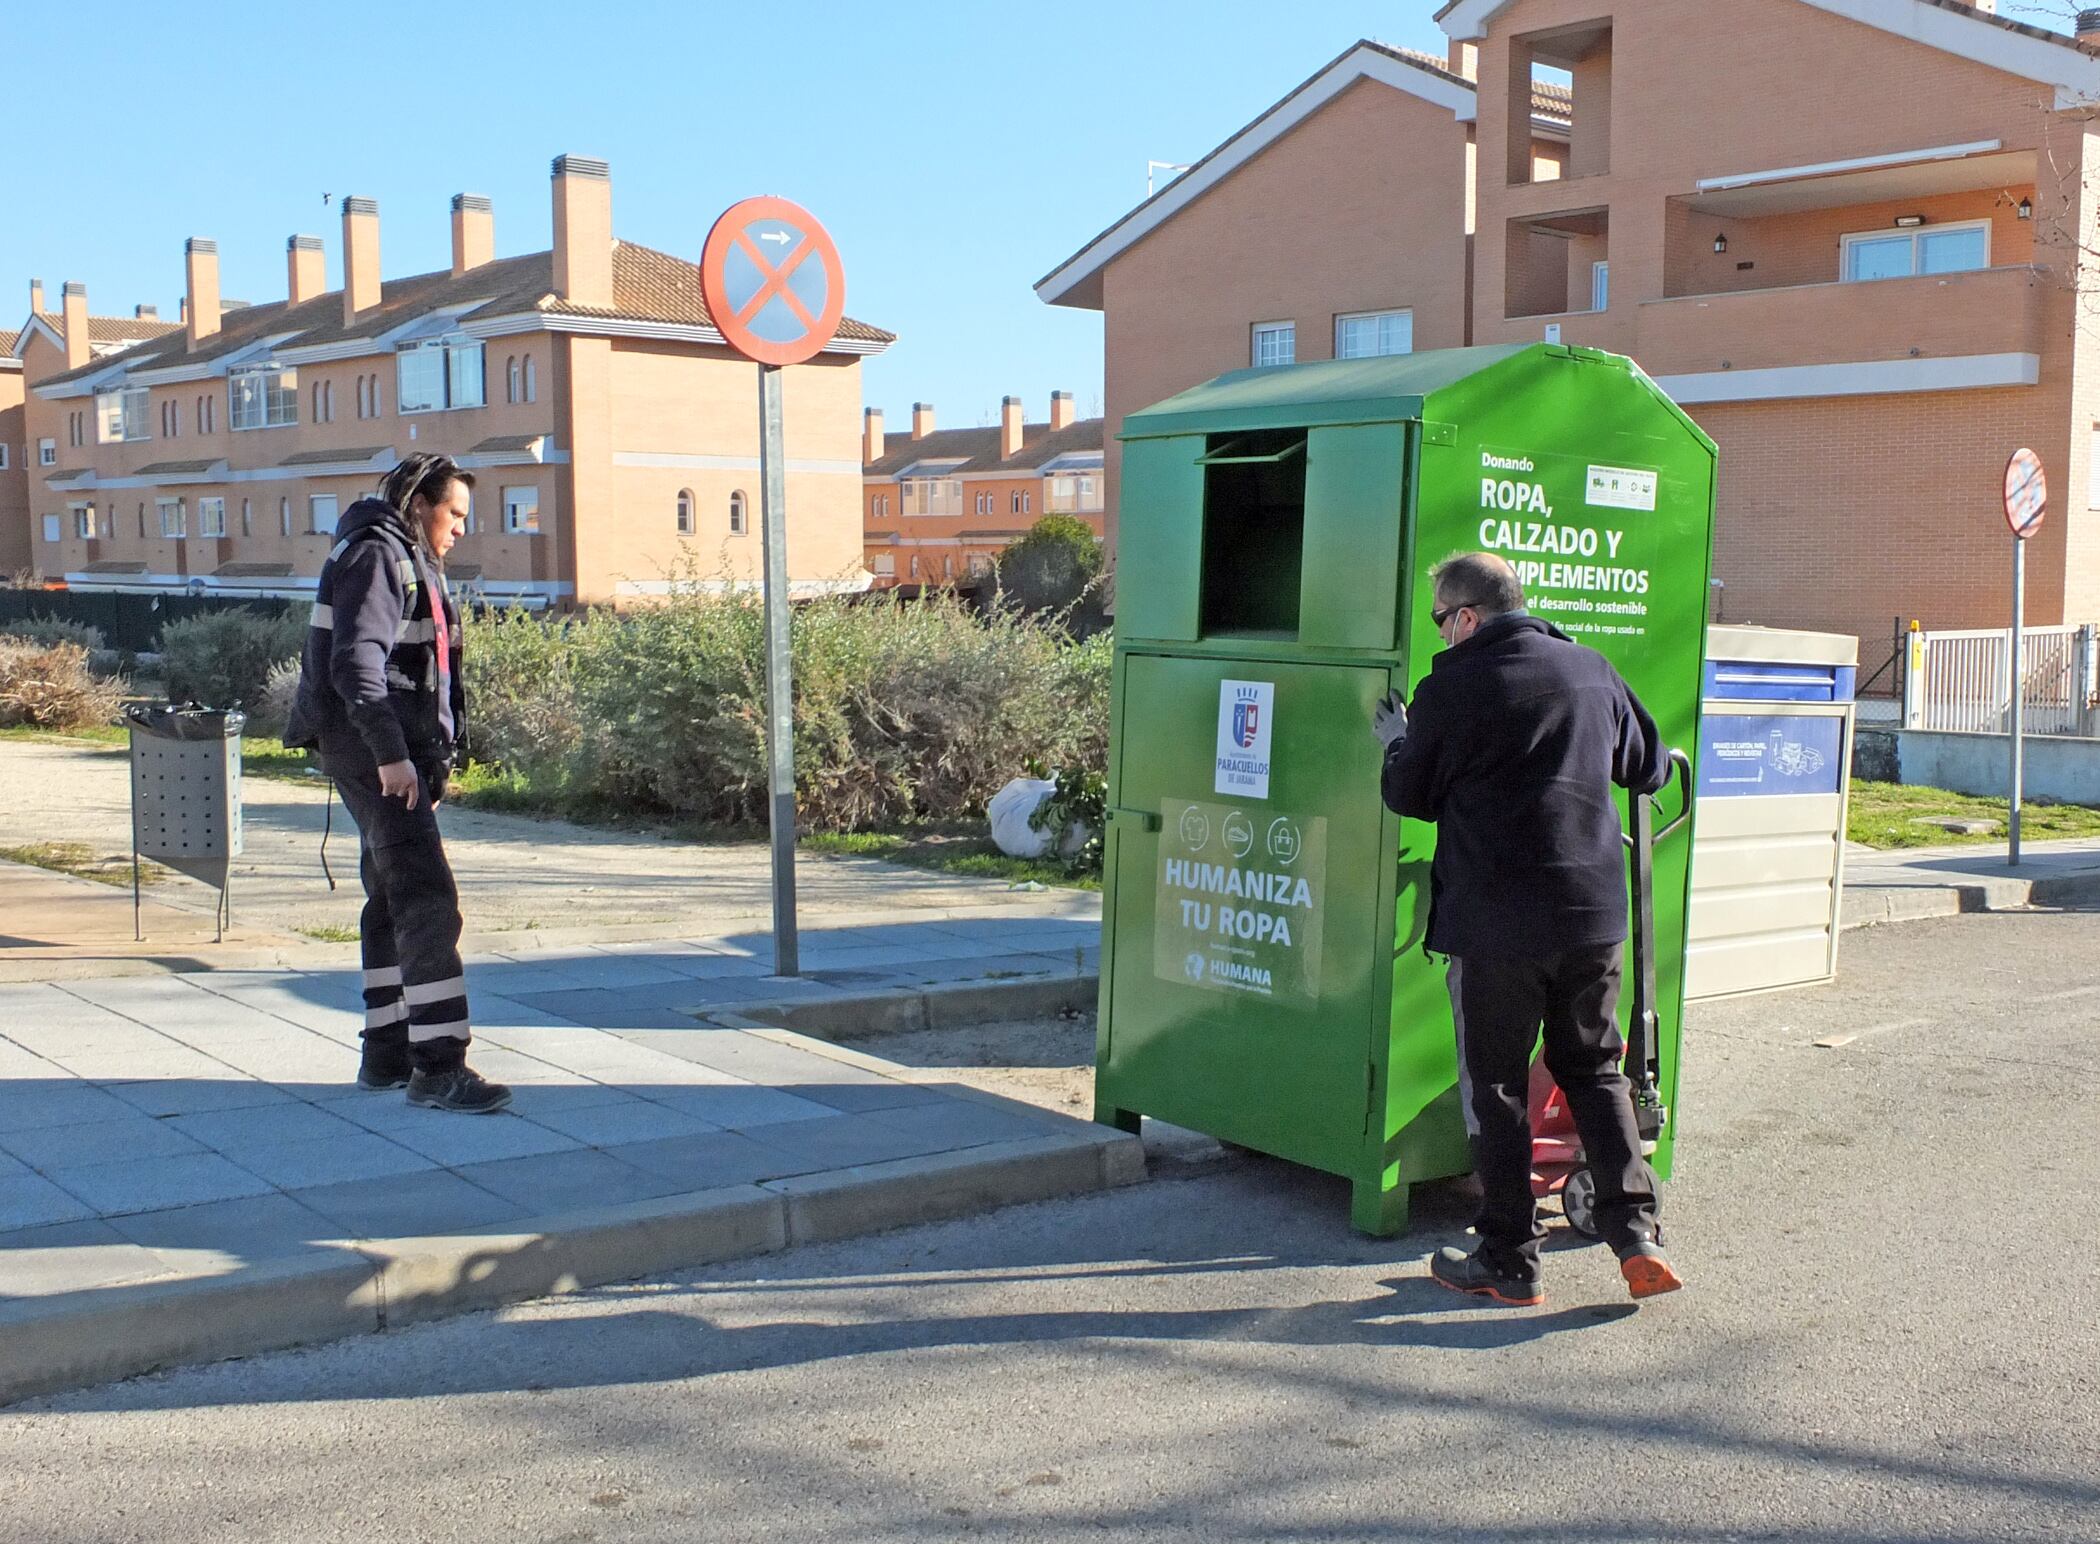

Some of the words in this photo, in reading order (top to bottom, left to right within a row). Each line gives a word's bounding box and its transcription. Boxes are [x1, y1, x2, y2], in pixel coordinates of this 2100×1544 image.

[1482, 452, 1534, 472] Donando
[1481, 478, 1553, 518] ROPA,
[1479, 518, 1598, 557] CALZADO
[1605, 530, 1623, 558] Y
[1507, 559, 1649, 594] MPLEMENTOS
[1528, 595, 1538, 609] el
[1540, 596, 1594, 612] desarrollo
[1595, 601, 1648, 615] sostenible
[1565, 622, 1584, 632] social
[1585, 622, 1593, 632] de
[1594, 623, 1601, 632] la
[1602, 626, 1616, 635] ropa
[1617, 624, 1635, 635] usada
[1217, 758, 1268, 775] PARACUELLOS
[1166, 858, 1313, 909] HUMANIZA
[1180, 899, 1211, 931] TU
[1218, 906, 1292, 947] ROPA
[1211, 960, 1272, 987] HUMANA
